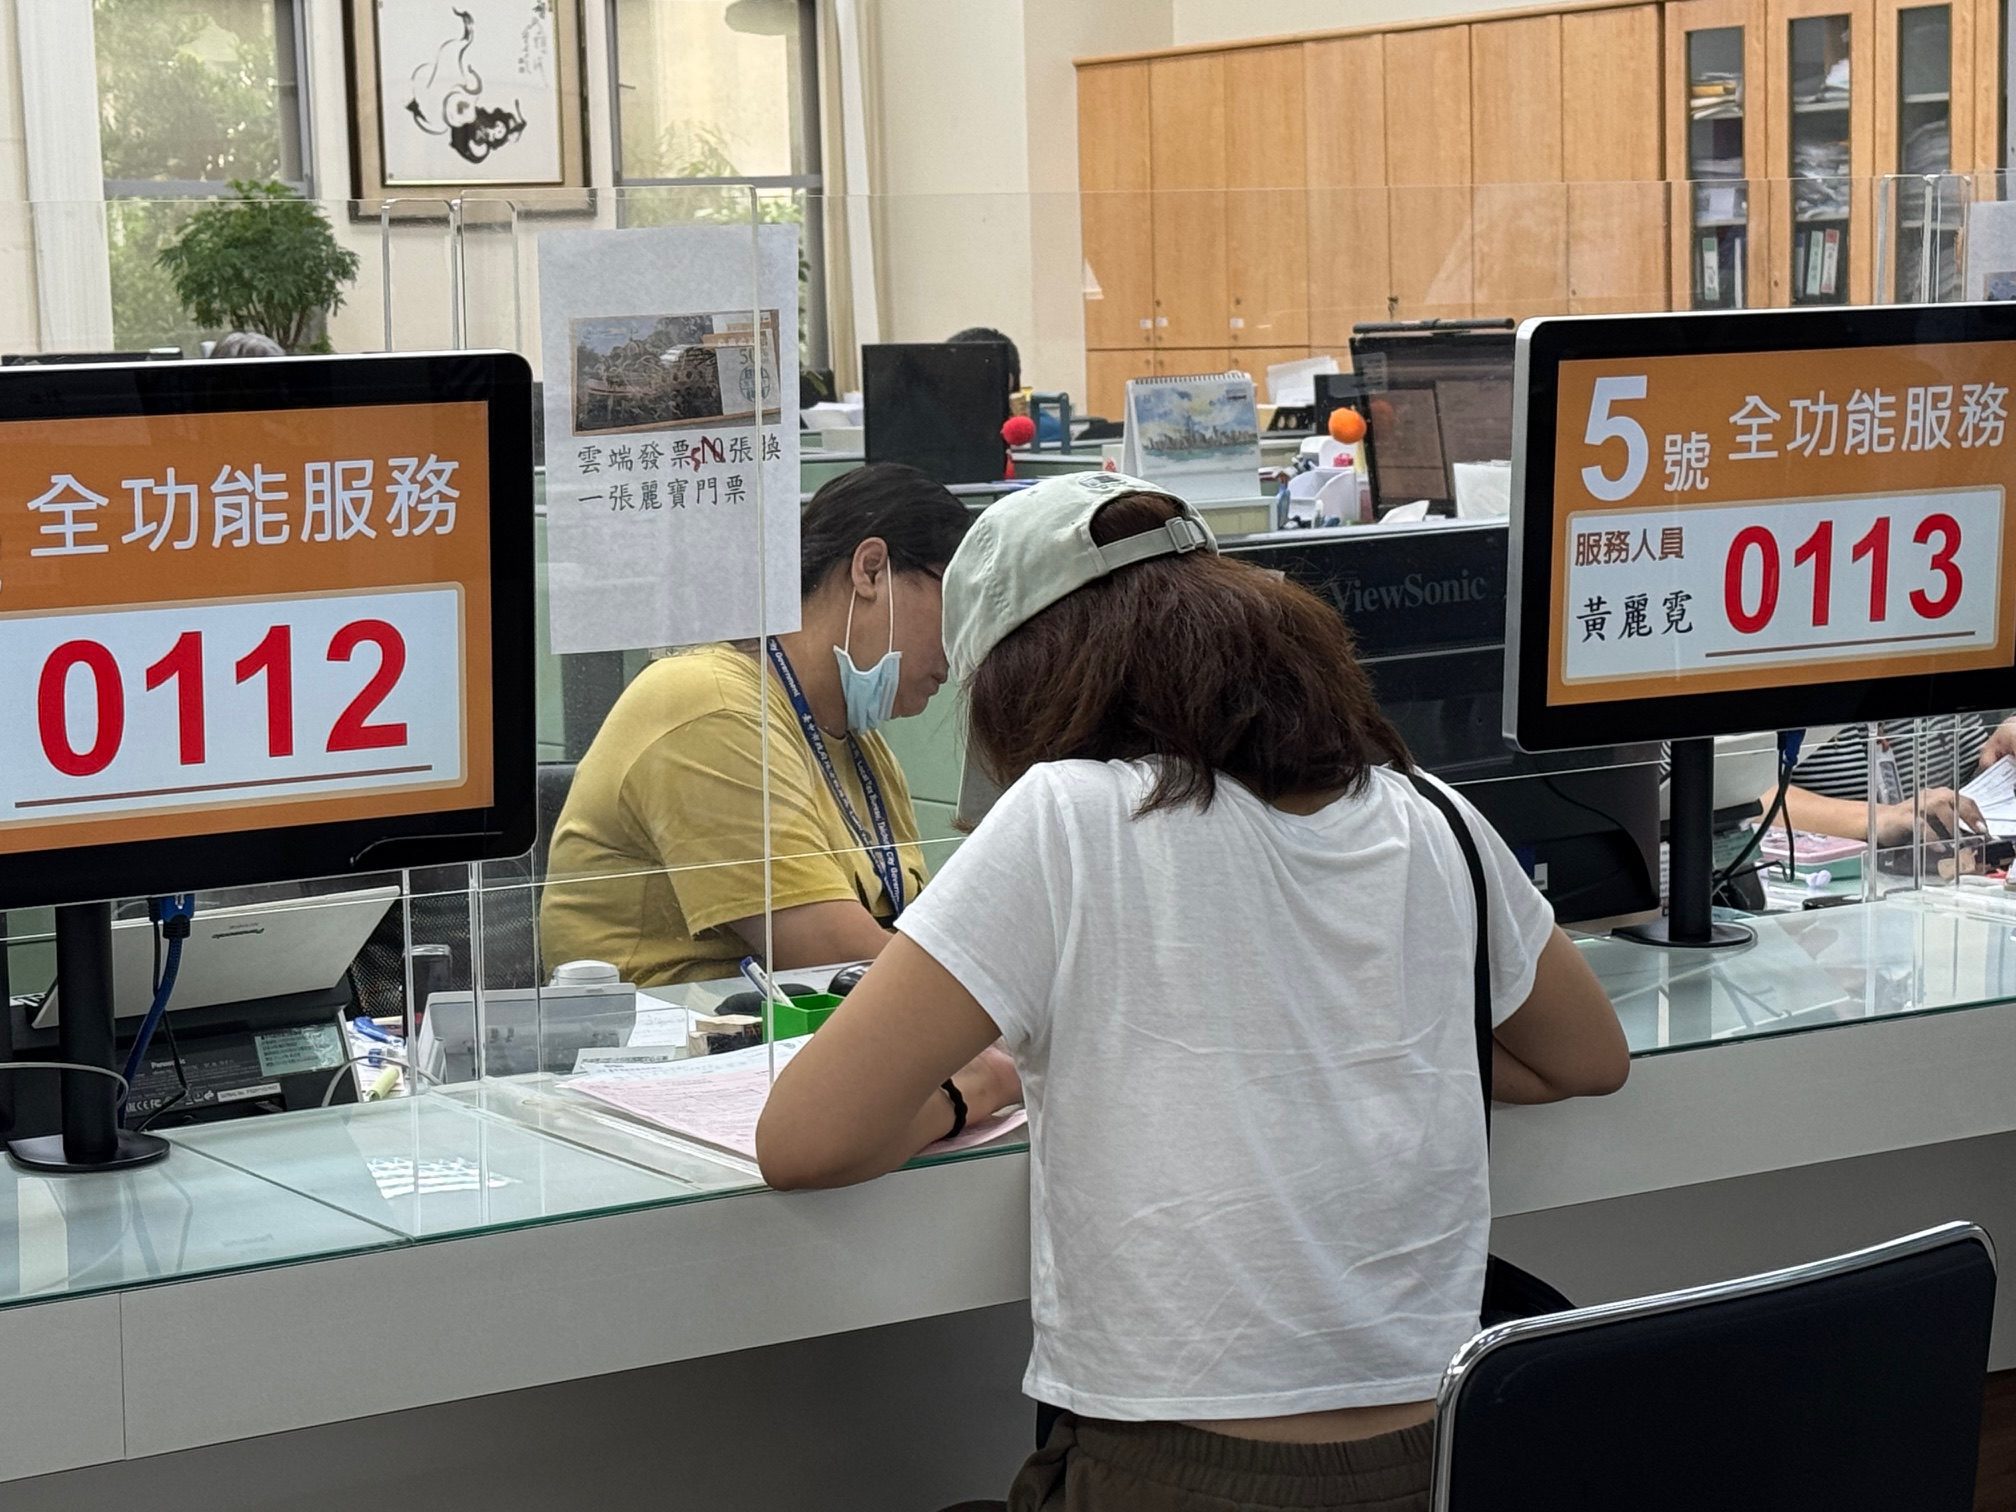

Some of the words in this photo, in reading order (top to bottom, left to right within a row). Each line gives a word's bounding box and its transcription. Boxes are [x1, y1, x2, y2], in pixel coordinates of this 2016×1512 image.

[1728, 382, 2010, 461] 全功能服務
[27, 453, 462, 557] 全功能服務
[577, 474, 747, 512] 一張麗寶門票
[1574, 527, 1685, 567] 服務人員
[1329, 568, 1488, 616] ViewSonic
[1723, 512, 1964, 635] 0113
[1575, 589, 1694, 643] 黃麗霓
[37, 618, 409, 777] 0112
[774, 651, 801, 698] Government
[886, 851, 896, 866] City
